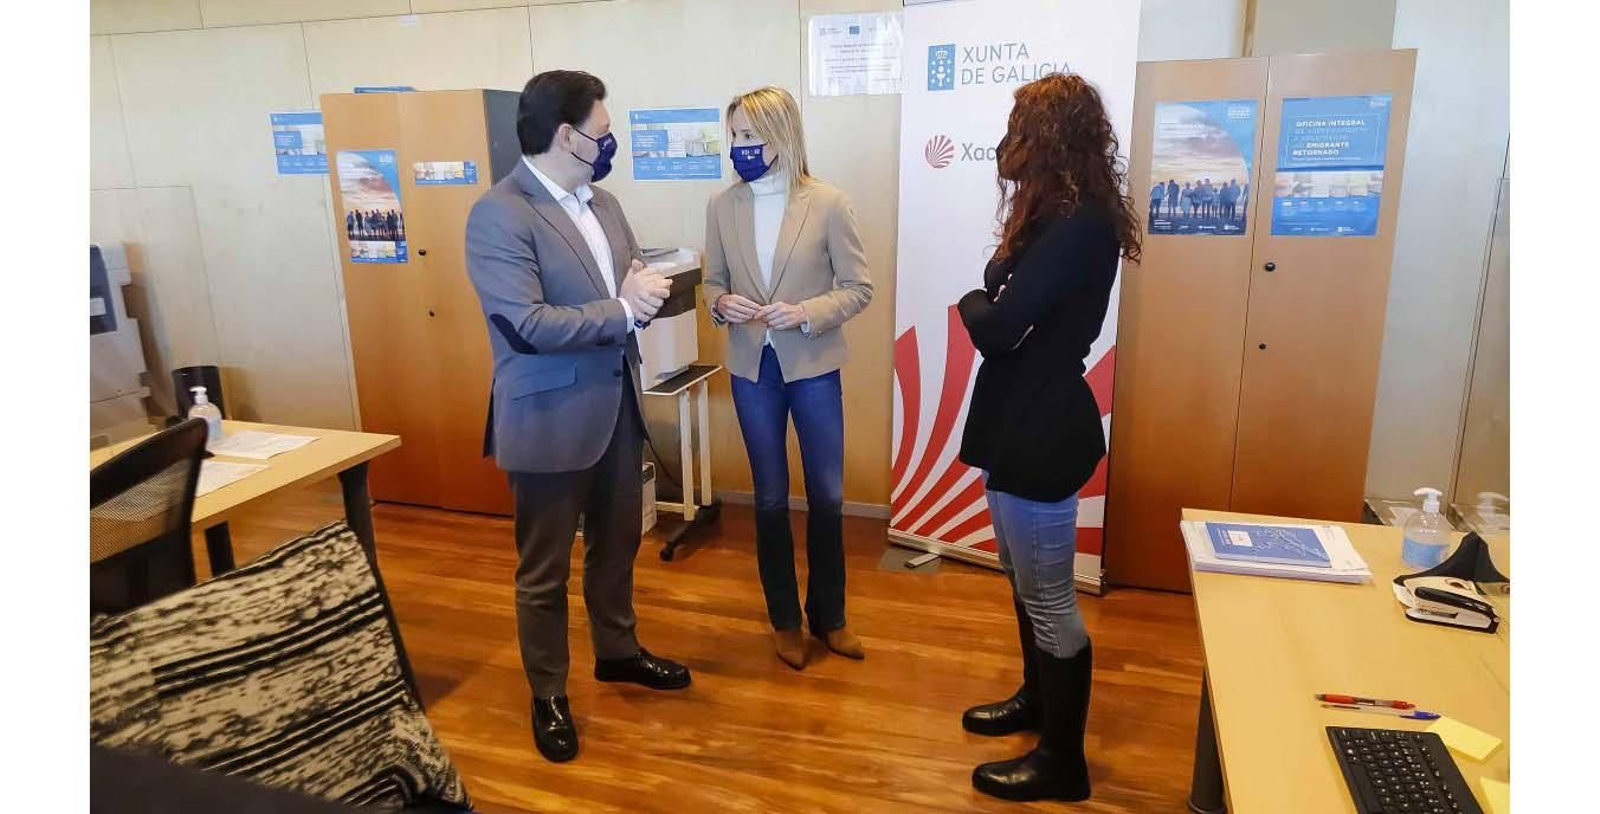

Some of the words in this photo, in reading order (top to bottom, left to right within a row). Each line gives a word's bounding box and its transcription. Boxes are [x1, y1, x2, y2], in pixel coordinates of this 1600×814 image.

[962, 42, 1030, 64] XUNTA
[961, 67, 985, 85] DE
[992, 62, 1071, 84] GALICIA
[1328, 119, 1365, 127] INTEGRAL
[960, 142, 997, 162] Xac
[1306, 141, 1350, 149] EMIGRANTE
